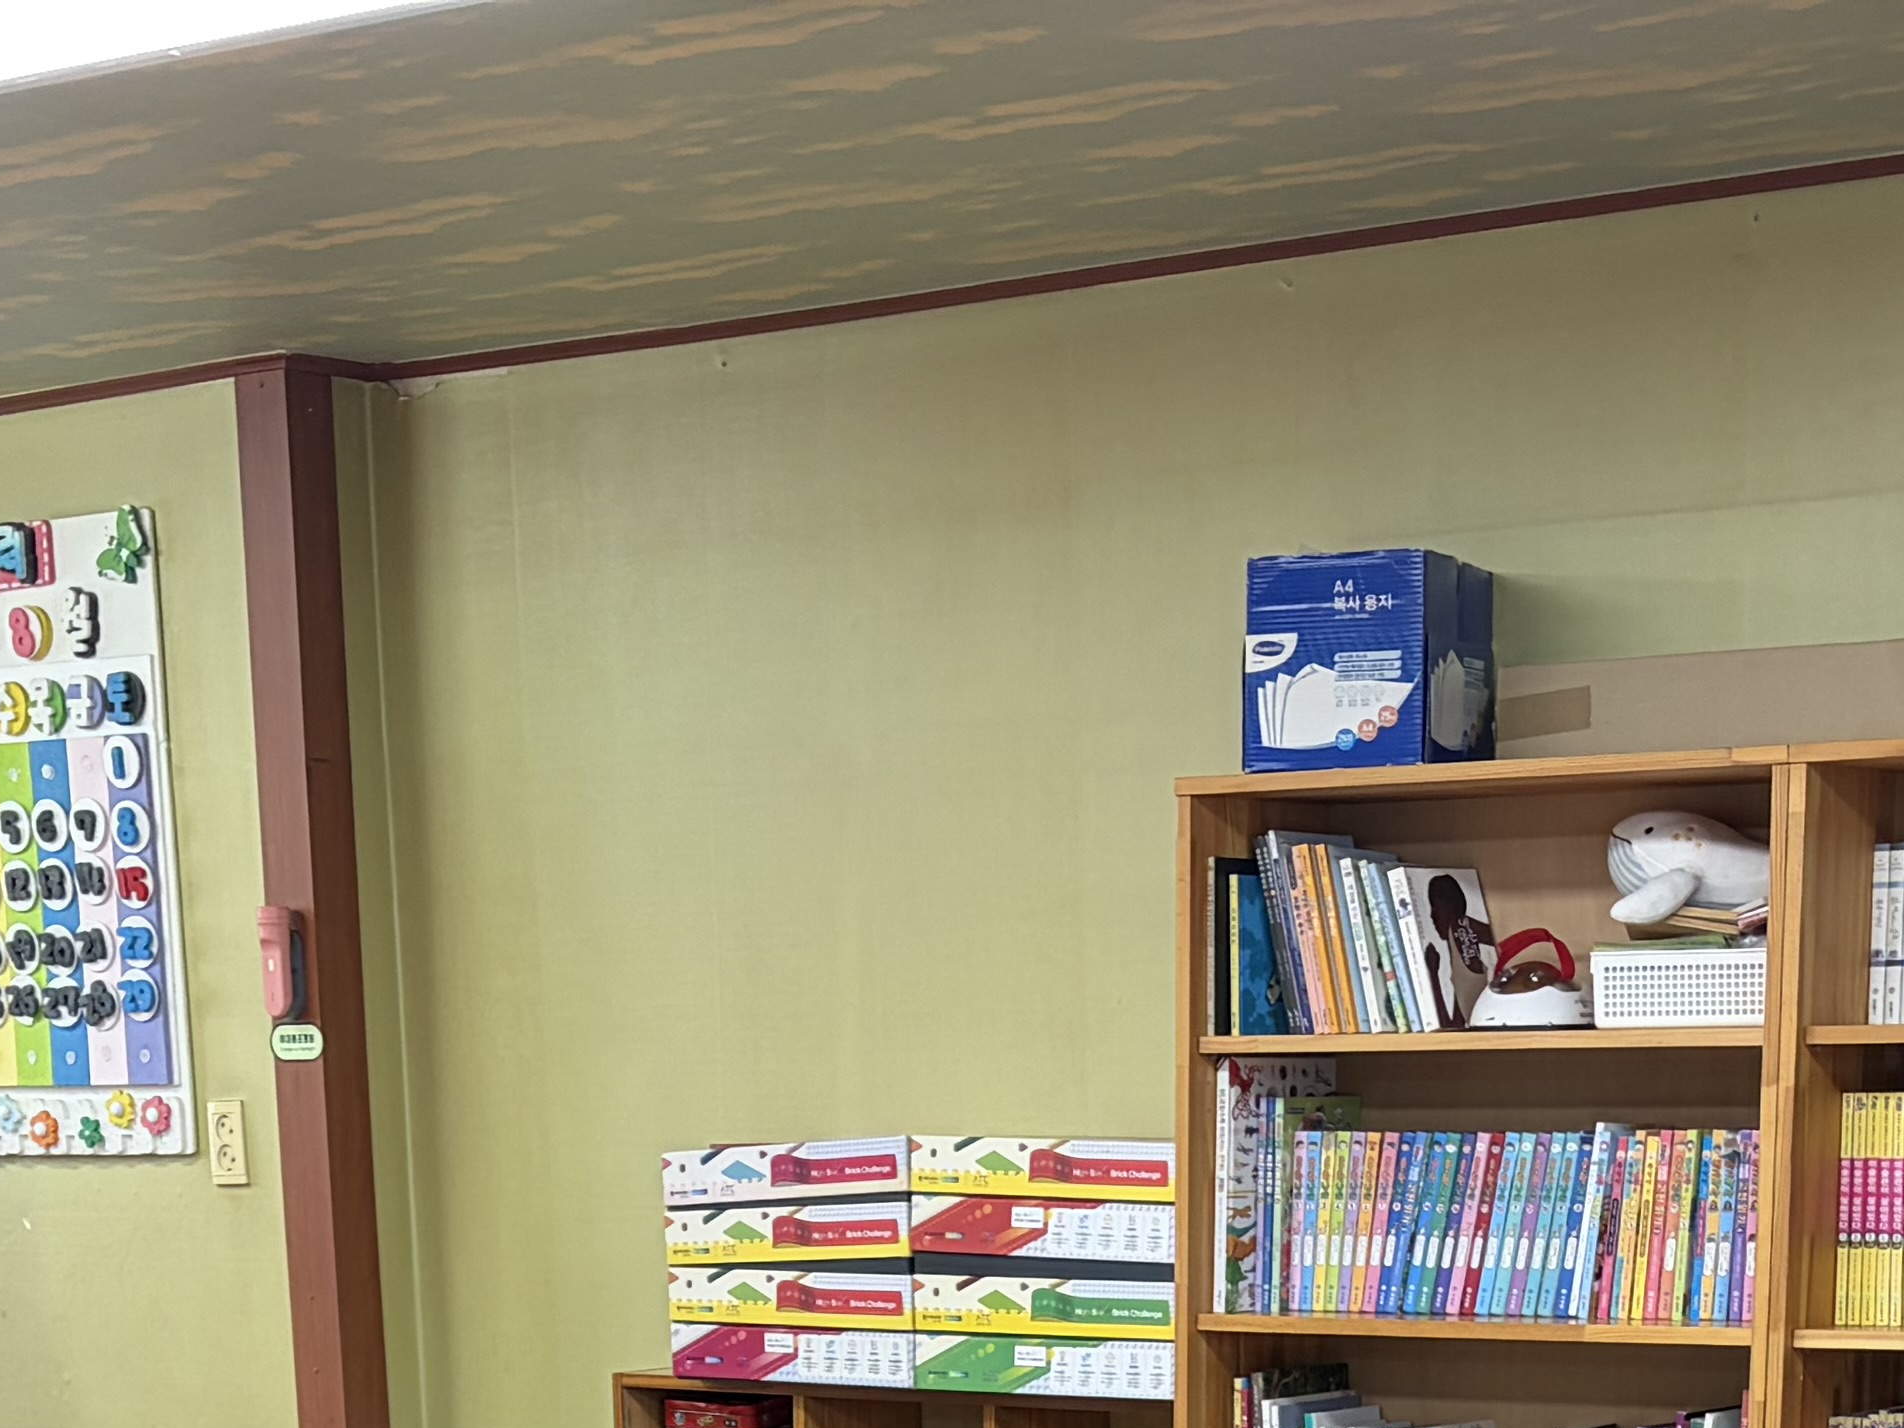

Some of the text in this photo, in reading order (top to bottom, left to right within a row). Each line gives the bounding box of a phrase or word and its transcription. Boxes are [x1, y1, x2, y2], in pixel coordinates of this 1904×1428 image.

[1333, 578, 1354, 594] A4
[1364, 593, 1393, 611] 용지
[8, 607, 36, 659] 8
[64, 588, 97, 657] 월
[106, 672, 135, 725] 토
[111, 745, 126, 780] 1
[0, 810, 21, 845] 5
[36, 809, 58, 843] 6
[74, 808, 98, 842] 7
[117, 807, 140, 846] 8
[4, 867, 32, 902] 12
[117, 866, 148, 902] 15
[6, 929, 37, 971] 19
[39, 932, 76, 968] 20
[75, 928, 107, 960] 21
[117, 926, 154, 960] 22
[5, 984, 39, 1018] 26
[43, 986, 81, 1019] 27
[117, 979, 156, 1013] 29
